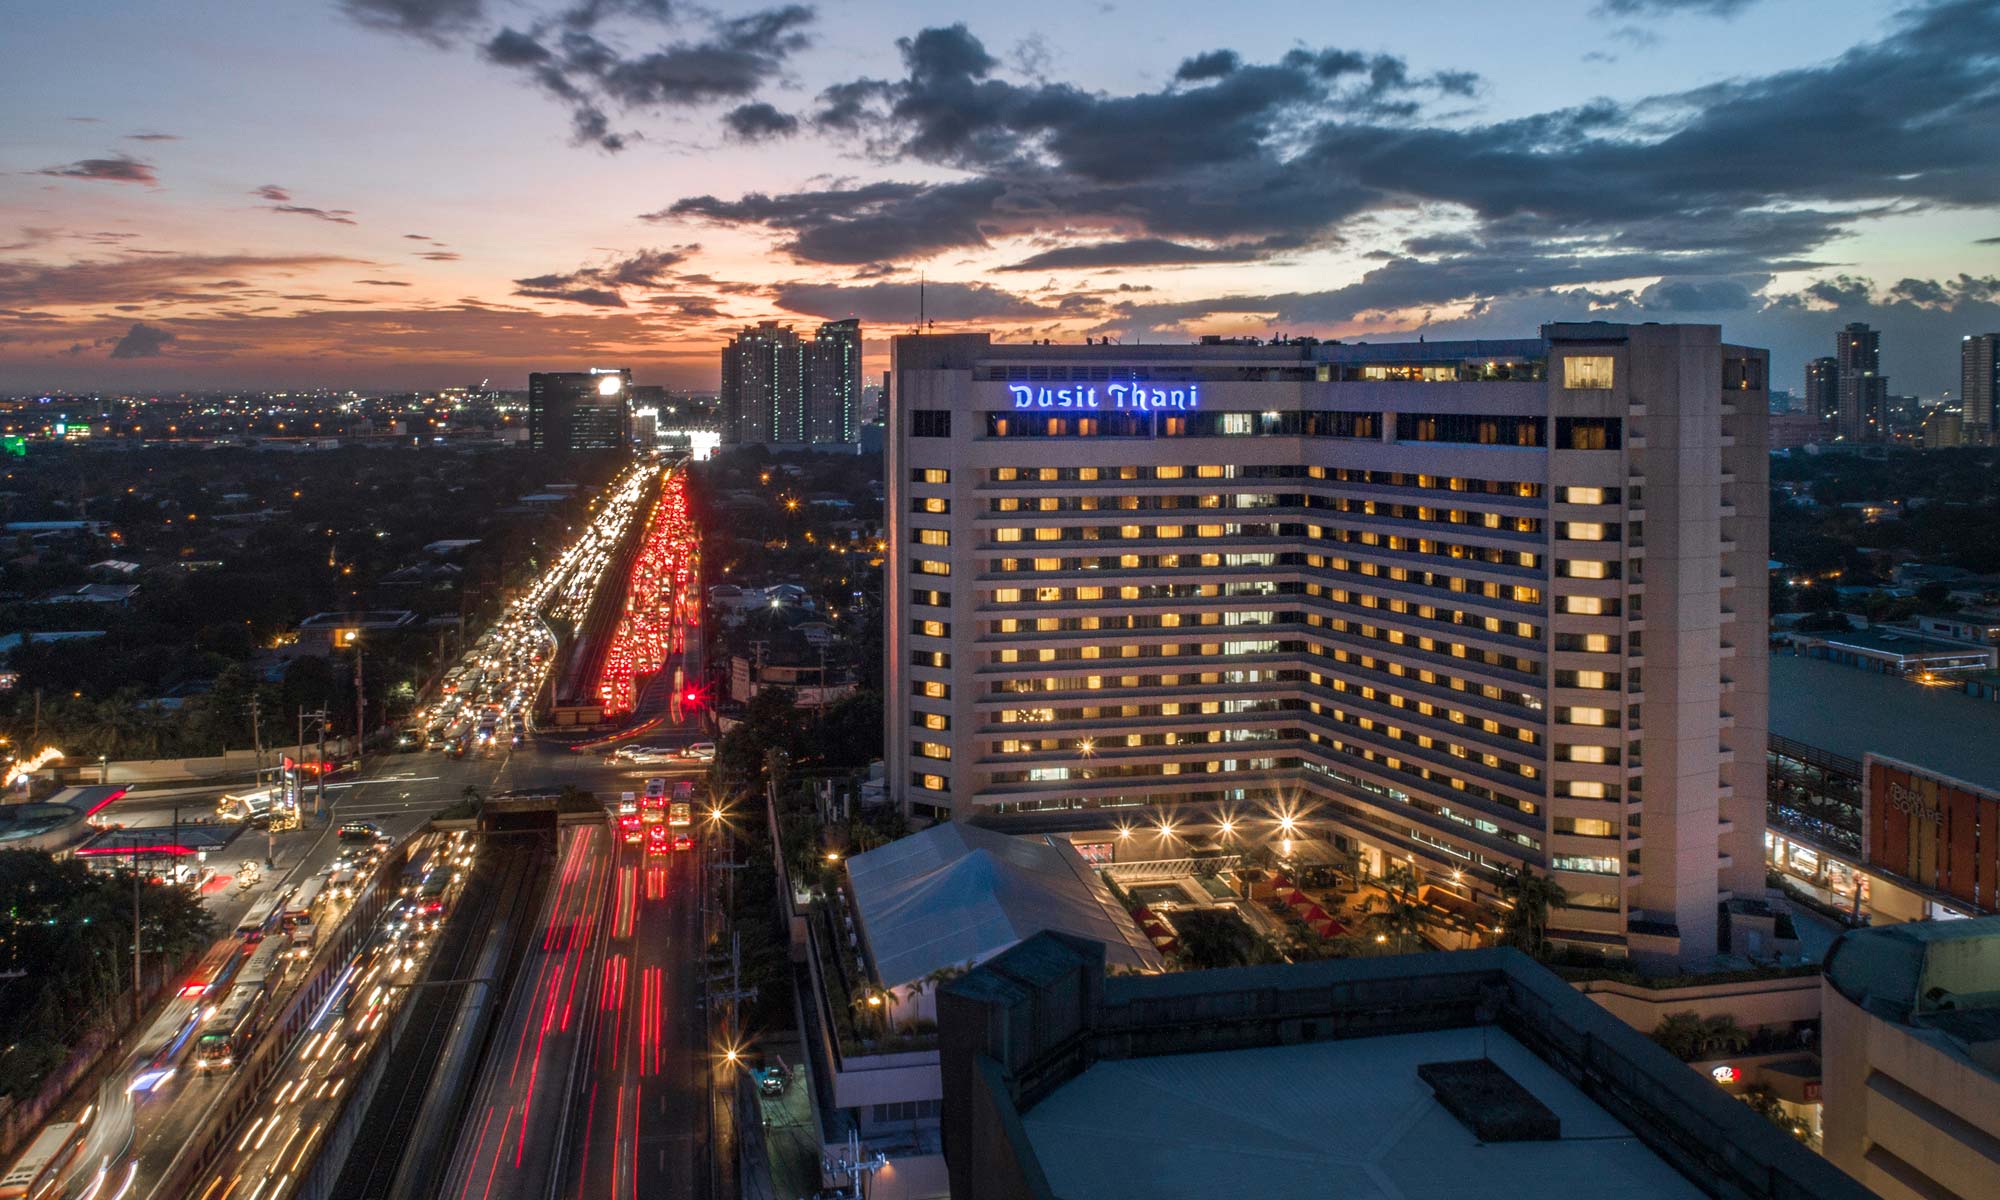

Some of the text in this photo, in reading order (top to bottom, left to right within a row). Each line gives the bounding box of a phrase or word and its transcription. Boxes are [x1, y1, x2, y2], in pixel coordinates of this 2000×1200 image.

[1009, 382, 1197, 411] Dusit Thani
[1893, 785, 1924, 803] PARK
[1893, 800, 1944, 826] SQUARE
